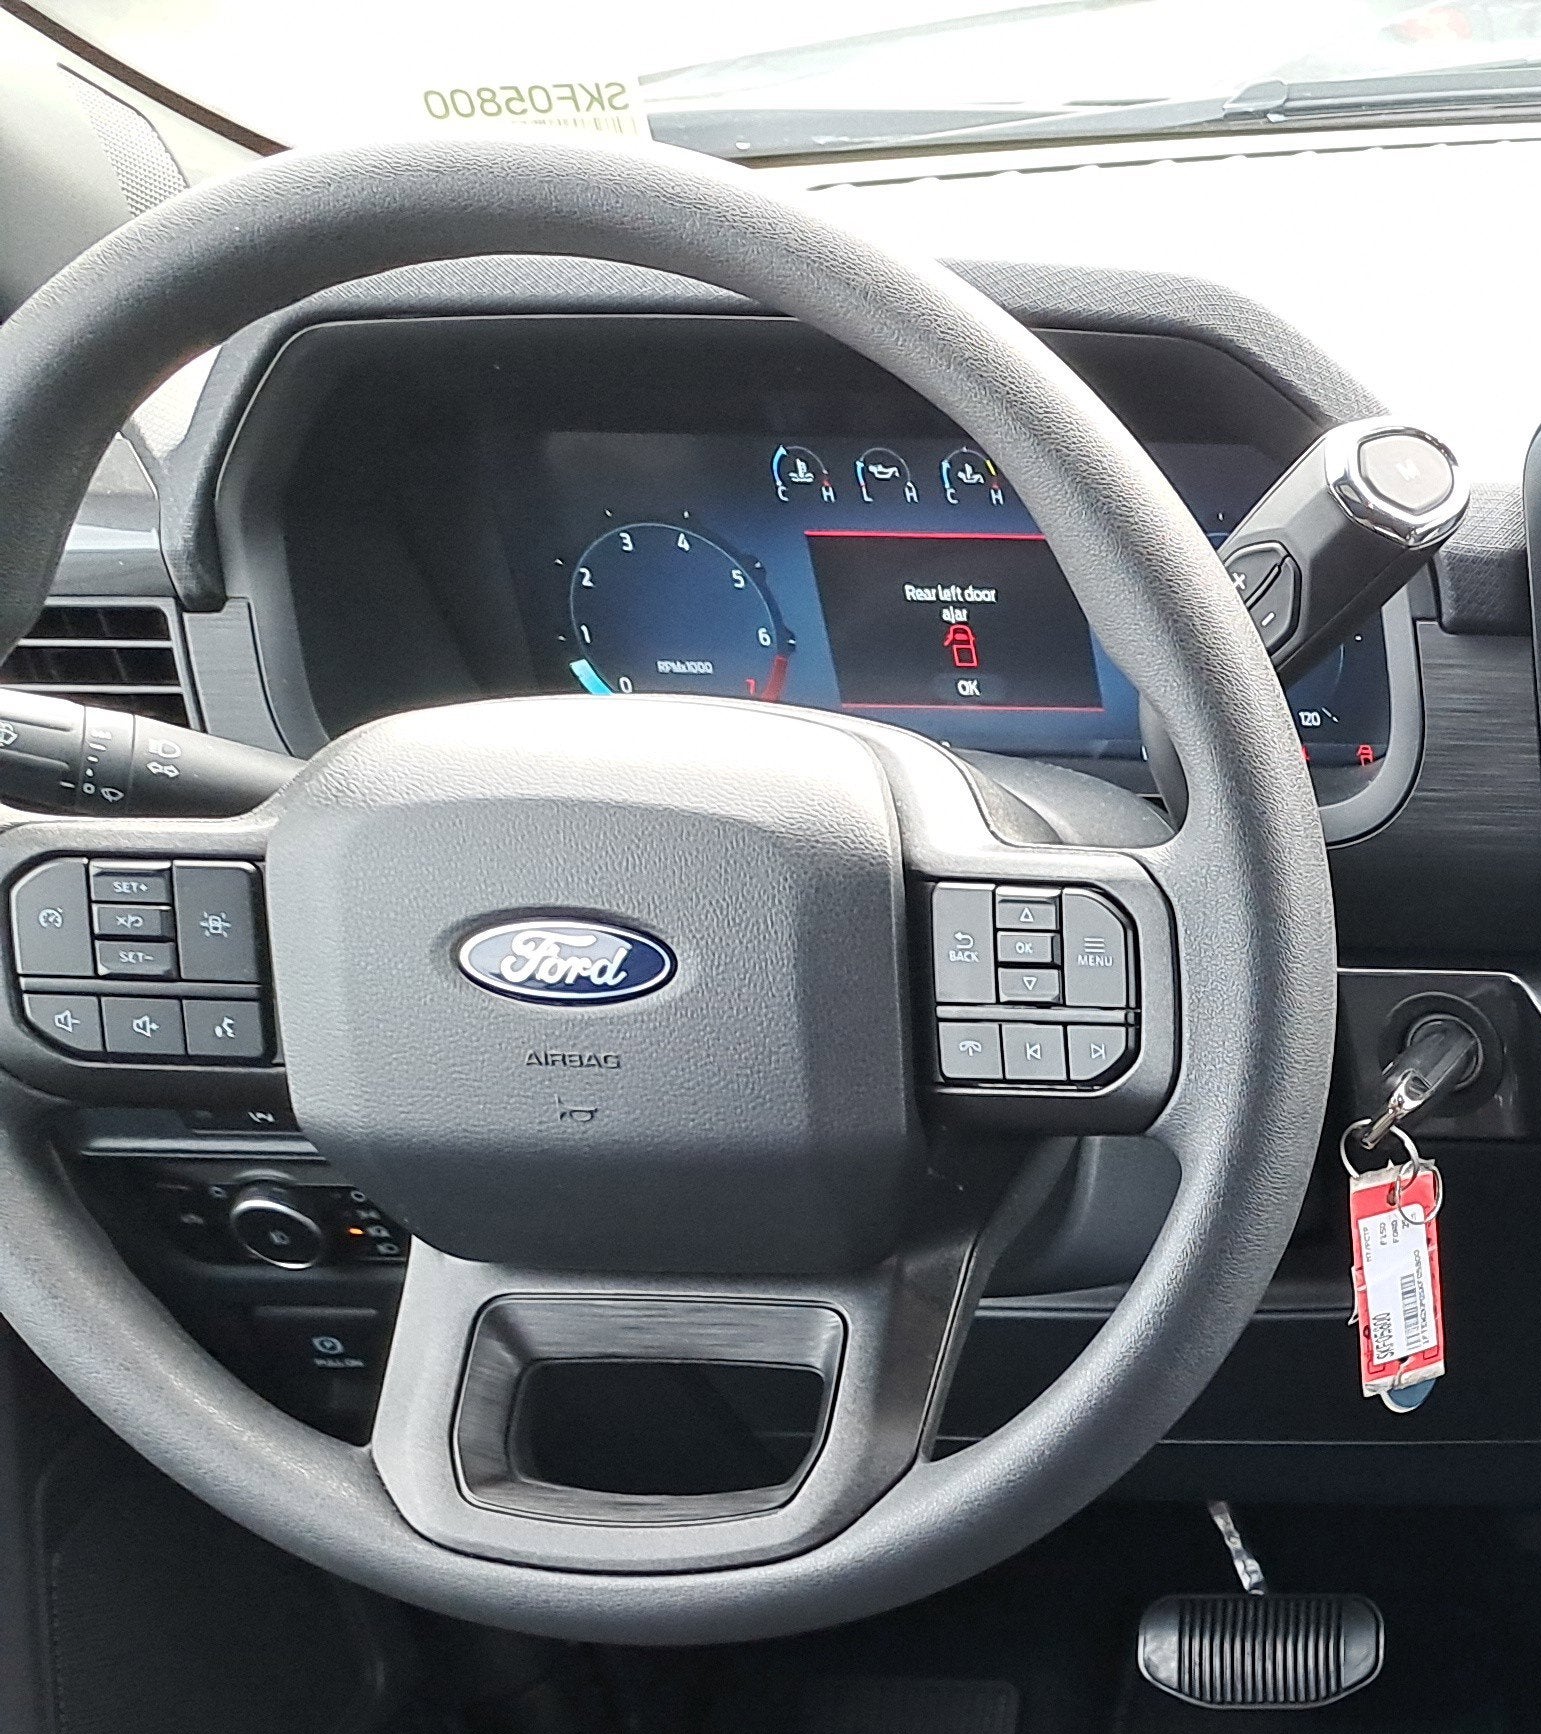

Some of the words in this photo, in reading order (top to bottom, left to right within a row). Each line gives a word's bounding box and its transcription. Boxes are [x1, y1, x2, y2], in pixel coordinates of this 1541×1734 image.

[776, 486, 789, 501] C
[821, 487, 835, 502] H
[861, 486, 873, 502] L
[905, 487, 918, 503] H
[947, 489, 959, 504] C
[991, 488, 1004, 505] H
[619, 532, 633, 551] 3
[677, 533, 690, 551] 4
[579, 568, 594, 588] 2
[732, 570, 745, 588] 5
[904, 584, 937, 602] Rear
[937, 584, 964, 602] left
[964, 585, 997, 602] door
[942, 605, 968, 623] ajar
[580, 625, 591, 643] 1
[758, 627, 771, 647] 6
[619, 676, 633, 694] 0
[957, 680, 980, 696] OK
[1299, 711, 1321, 727] 120
[948, 950, 980, 963] BACK
[1015, 942, 1033, 954] OK
[500, 930, 633, 987] Ford
[1077, 955, 1113, 967] MENU
[525, 1051, 622, 1070] AIRBAG
